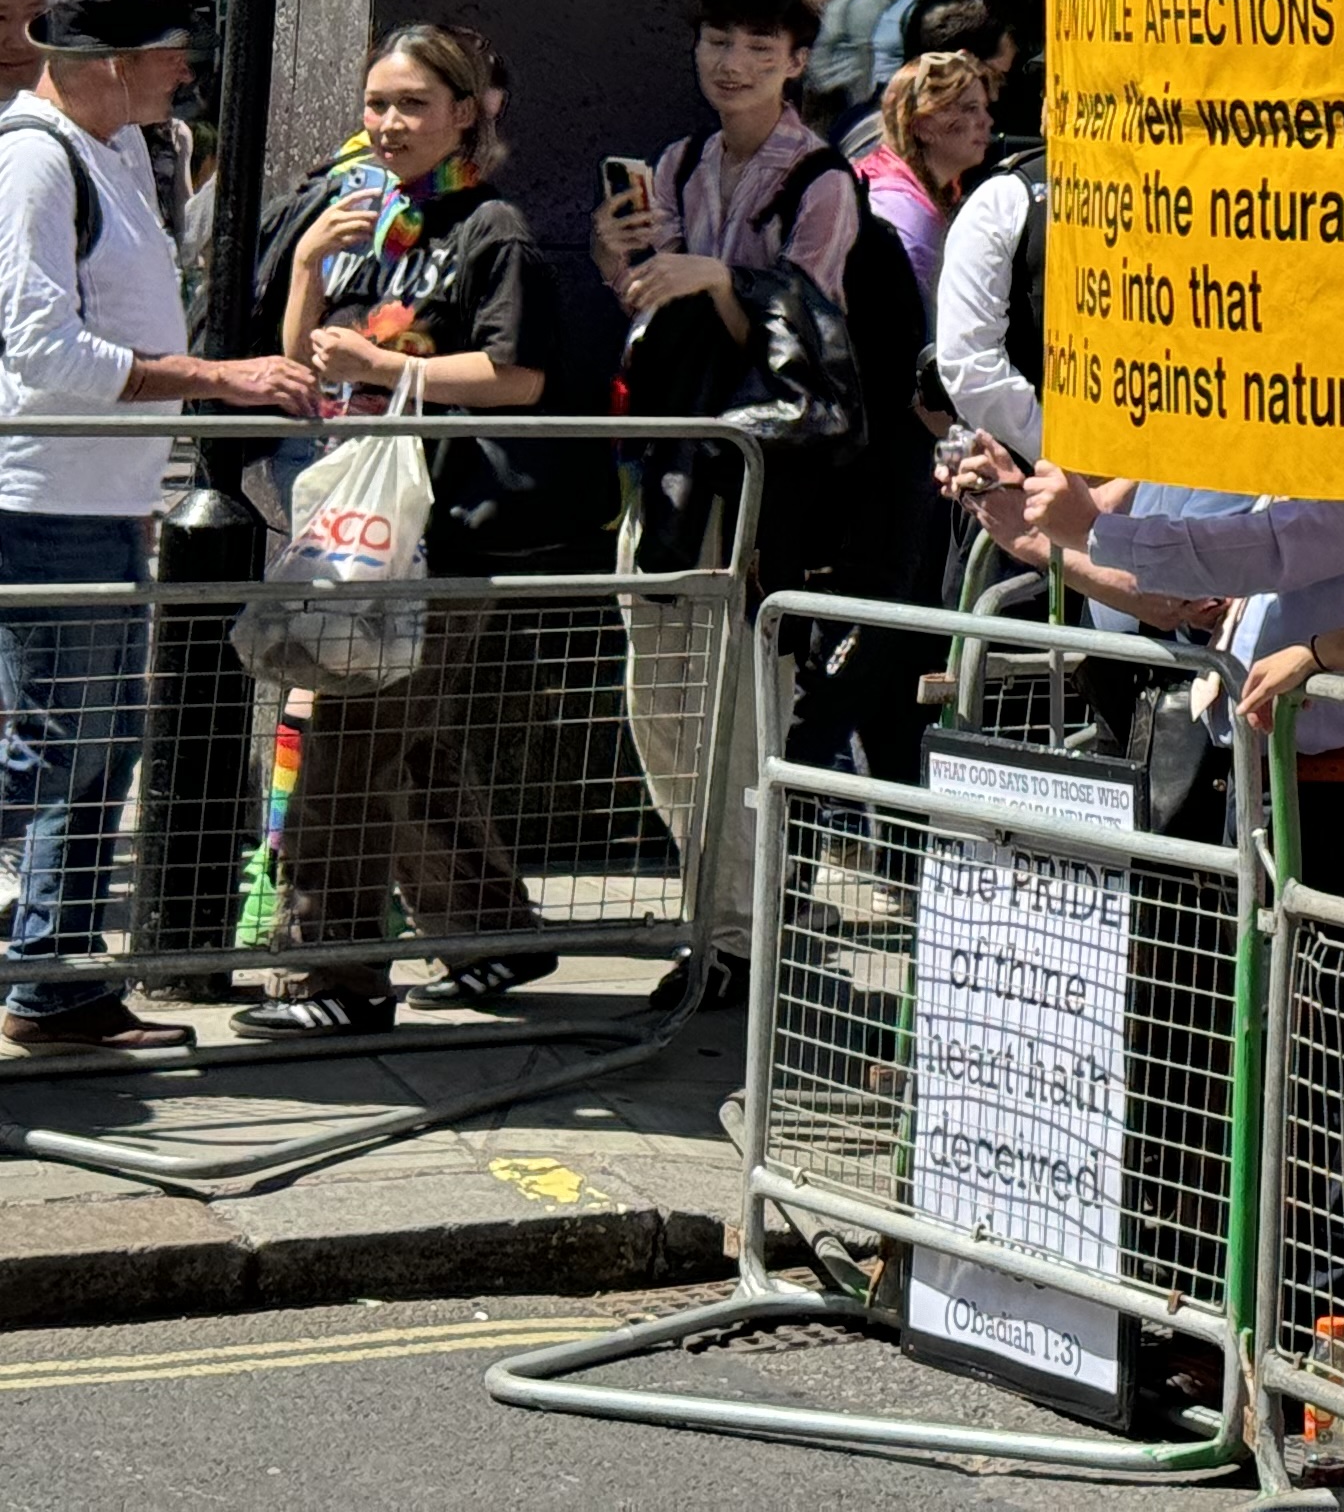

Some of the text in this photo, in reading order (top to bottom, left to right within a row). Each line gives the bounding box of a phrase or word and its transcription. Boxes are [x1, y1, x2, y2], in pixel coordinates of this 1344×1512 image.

[1074, 91, 1119, 142] even
[1121, 80, 1184, 147] their
[1064, 167, 1135, 248] change
[1142, 169, 1193, 237] the
[1075, 257, 1262, 334] use into that
[1048, 335, 1078, 402] hich
[1083, 337, 1101, 405] is
[1113, 352, 1227, 428] against
[931, 759, 967, 782] WHAT
[969, 765, 997, 787] GOD
[999, 770, 1030, 795] SAYS
[1031, 776, 1050, 797] TO
[1051, 778, 1094, 806] THOSE
[1097, 786, 1130, 810] WHO
[932, 836, 1126, 929] The PRIDE
[951, 936, 1087, 1017] of thine
[923, 1015, 1114, 1118] heart hath
[929, 1110, 1104, 1210] deceived
[944, 1297, 1083, 1377] (Obadiah 1:3)
